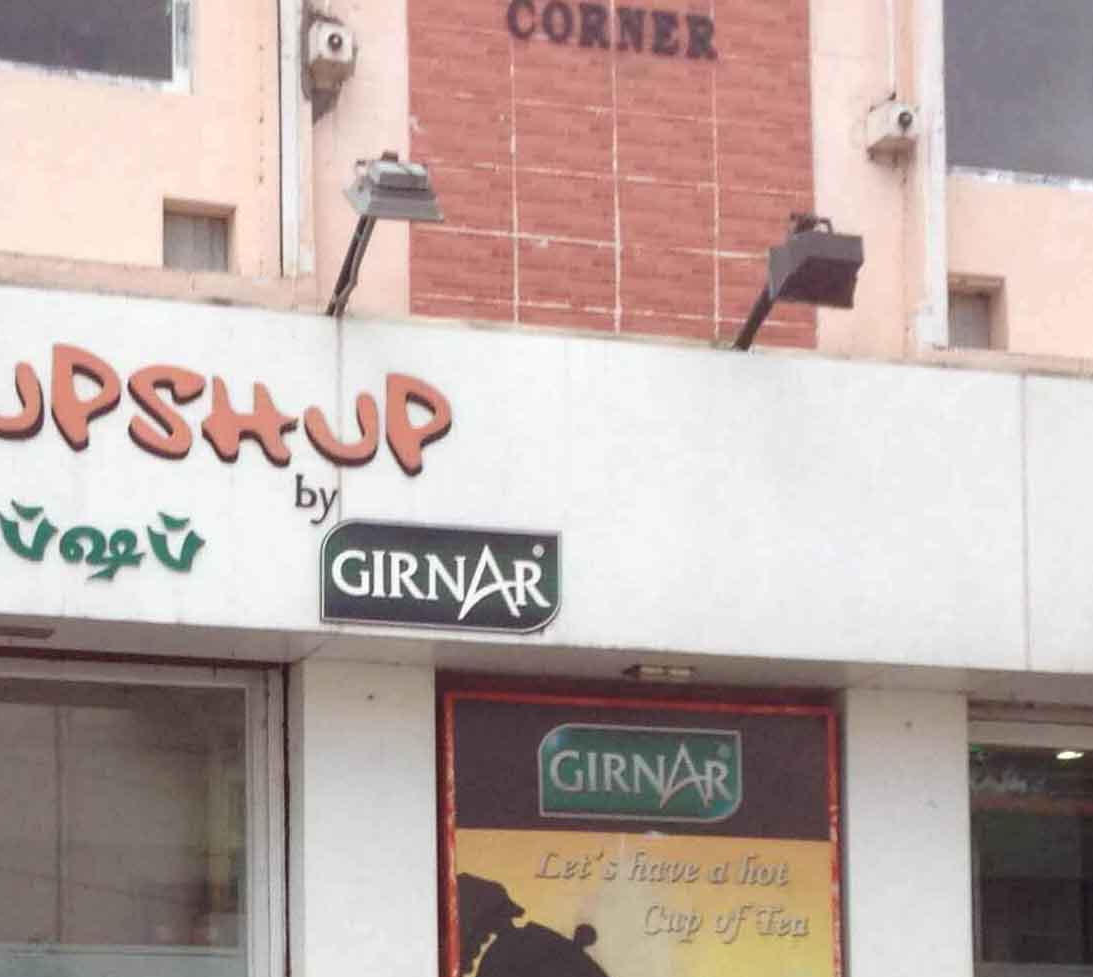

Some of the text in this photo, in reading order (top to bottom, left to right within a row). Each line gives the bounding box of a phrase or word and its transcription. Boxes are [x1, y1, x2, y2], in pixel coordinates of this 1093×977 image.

[507, 0, 719, 59] CORNER
[295, 473, 338, 524] by
[534, 852, 790, 888] Let's have a hot
[643, 905, 811, 945] Cup of Tea
